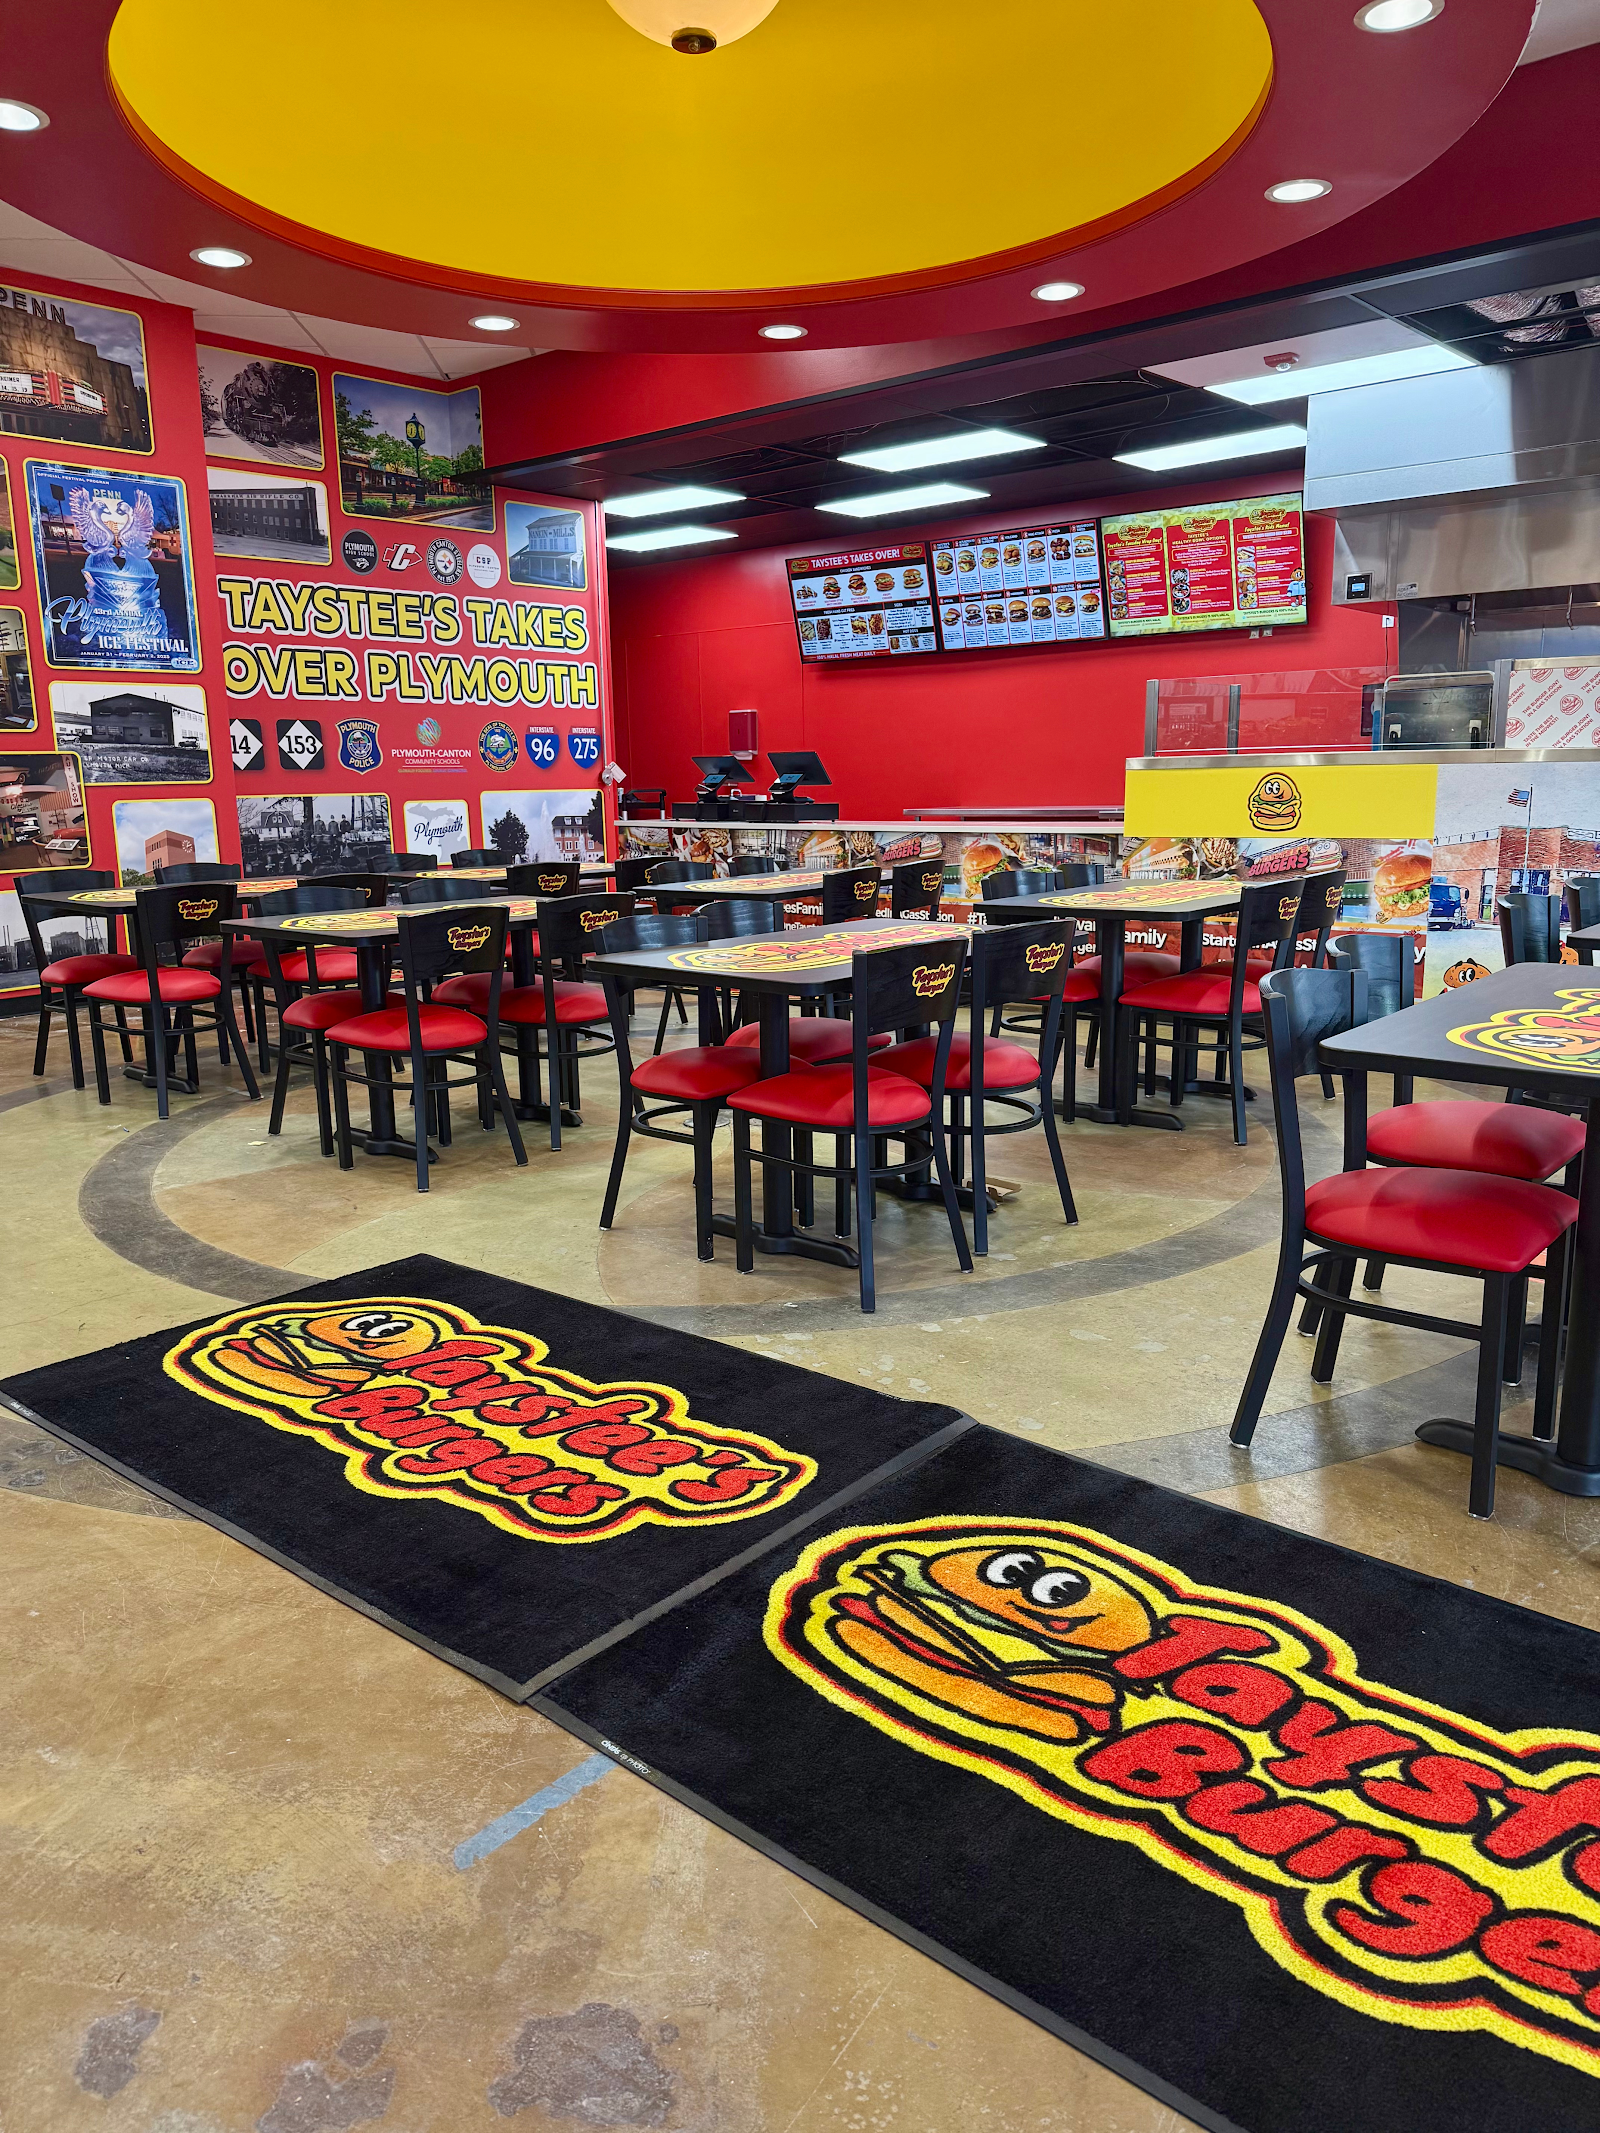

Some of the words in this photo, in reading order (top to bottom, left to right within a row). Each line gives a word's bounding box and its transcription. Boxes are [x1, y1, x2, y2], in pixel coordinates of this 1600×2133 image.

[93, 488, 122, 499] PENN
[553, 527, 575, 538] MILLS
[344, 541, 375, 552] PLYMOUTH
[436, 540, 455, 551] CANTON
[811, 555, 849, 568] TAYSTEE'S
[849, 552, 874, 564] TAKES
[874, 548, 900, 560] OVER!
[45, 596, 163, 645] Plymouth
[93, 608, 112, 616] 43rd
[114, 609, 143, 618] ANNUAL
[219, 578, 460, 641] TAYSTEE'S
[466, 600, 588, 651] TAKES
[99, 635, 122, 650] ICE
[126, 637, 189, 653] FESTIVAL
[224, 644, 358, 697] OVER
[368, 653, 598, 705] PLYMOUTH
[1522, 705, 1532, 714] THE
[1531, 690, 1548, 707] BURGER
[1546, 679, 1560, 694] JOINT
[1580, 681, 1591, 691] THE
[1536, 700, 1545, 711] GAS
[1544, 684, 1563, 702] STATION!
[340, 722, 377, 733] PLYMOUTH
[1523, 730, 1536, 743] TASTE
[1535, 722, 1545, 733] THE
[1542, 714, 1554, 726] BEST
[1530, 732, 1541, 744] THE
[1539, 716, 1560, 736] MIDWEST!
[1551, 738, 1562, 748] THE
[1560, 723, 1578, 741] BURGER
[1577, 713, 1591, 727] JOINT
[1565, 734, 1576, 744] GAS
[1574, 718, 1594, 735] STATION!
[231, 735, 252, 755] 14
[285, 735, 317, 755] 153
[391, 748, 472, 758] PLYMOUTH-CANTON
[531, 738, 555, 761] 96
[573, 737, 599, 760] 275
[349, 756, 375, 768] POLICE
[70, 781, 79, 803] SHOW
[414, 815, 463, 845] Plymouth
[882, 843, 921, 862] BURGERS
[1248, 853, 1309, 877] BURGERS
[1027, 945, 1064, 963] Taystee's
[914, 965, 953, 985] Taystee's
[382, 1338, 779, 1501] Taystee's
[315, 1384, 629, 1515] Burgers
[1112, 1615, 1600, 1896] Tayst
[1081, 1721, 1600, 2016] Burge
